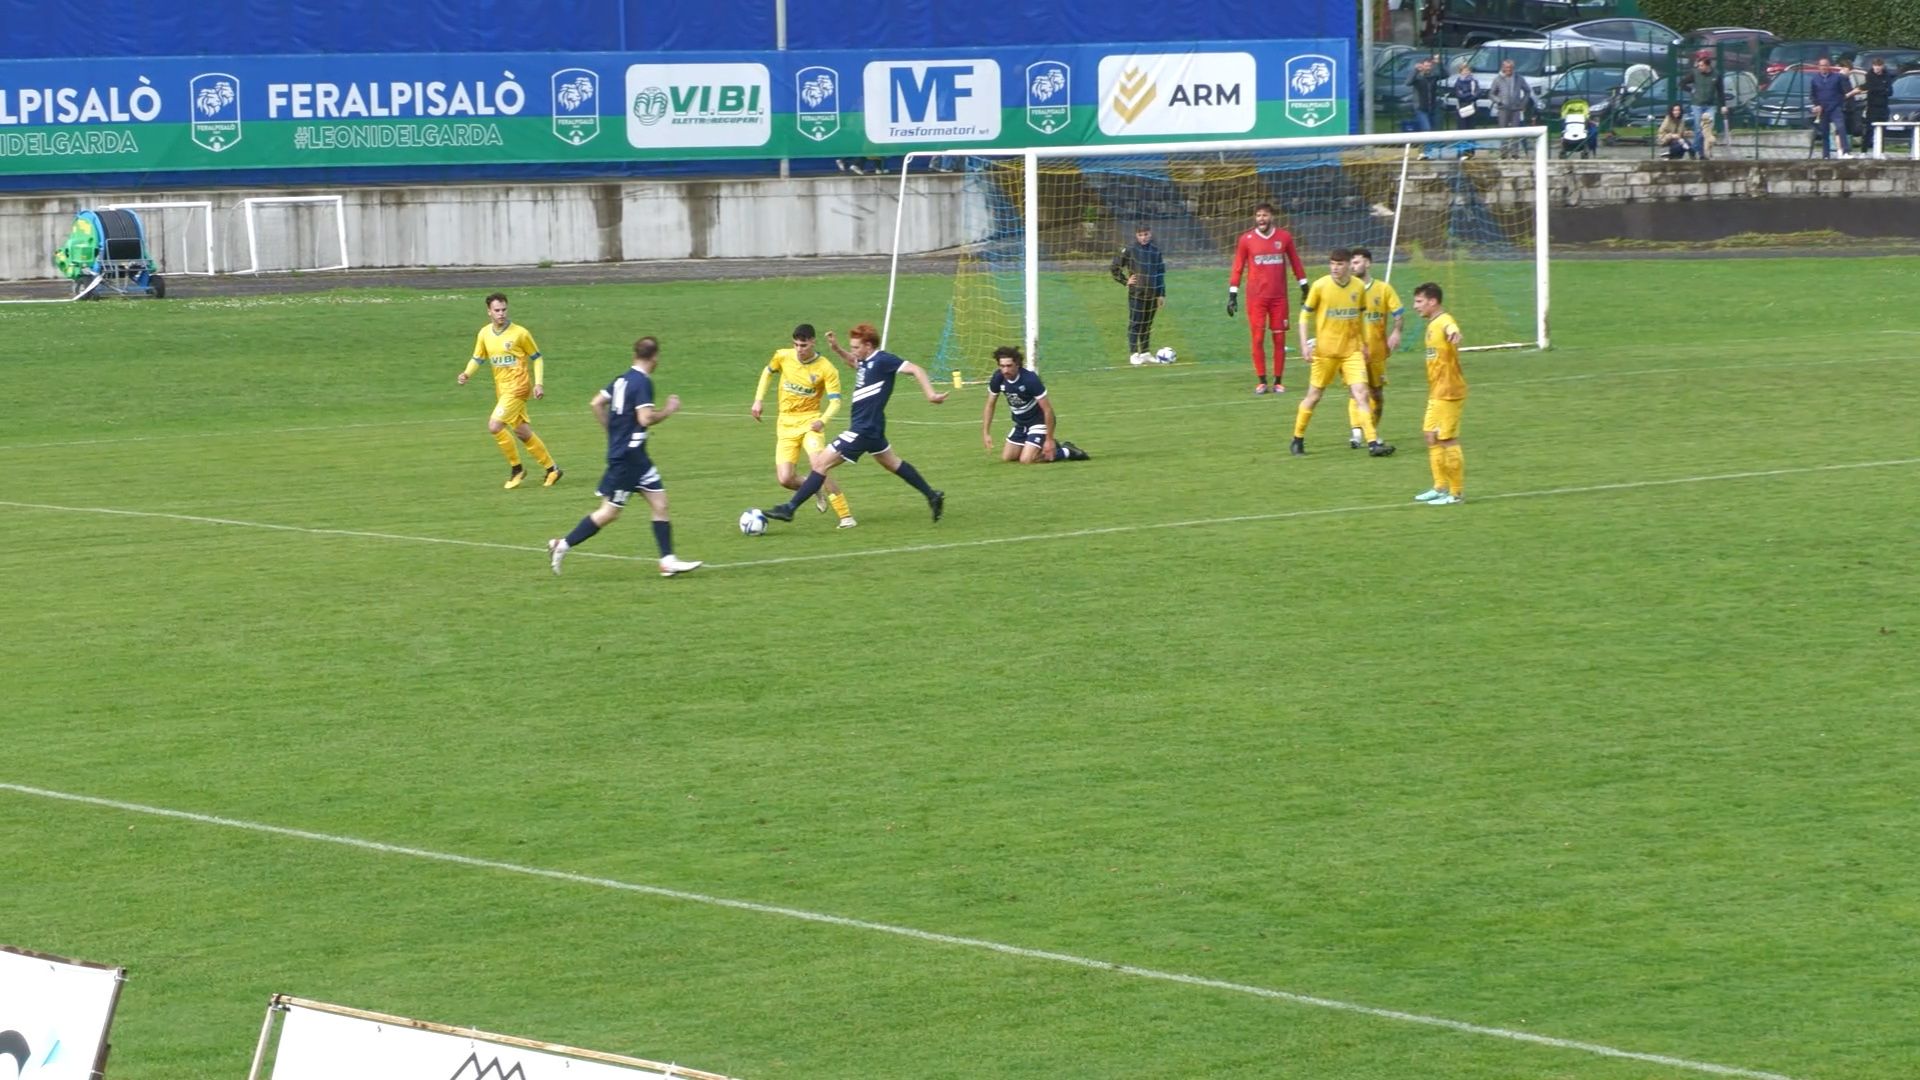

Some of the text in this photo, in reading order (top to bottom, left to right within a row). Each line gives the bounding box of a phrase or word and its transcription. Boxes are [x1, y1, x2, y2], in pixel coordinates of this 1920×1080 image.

[268, 70, 525, 119] FERALPISALÒ
[669, 85, 763, 115] VI.BI.
[889, 65, 974, 123] MF
[1168, 83, 1240, 107] ARM
[295, 124, 503, 150] #LEONIDELGARDA
[889, 126, 976, 137] Trasformatori
